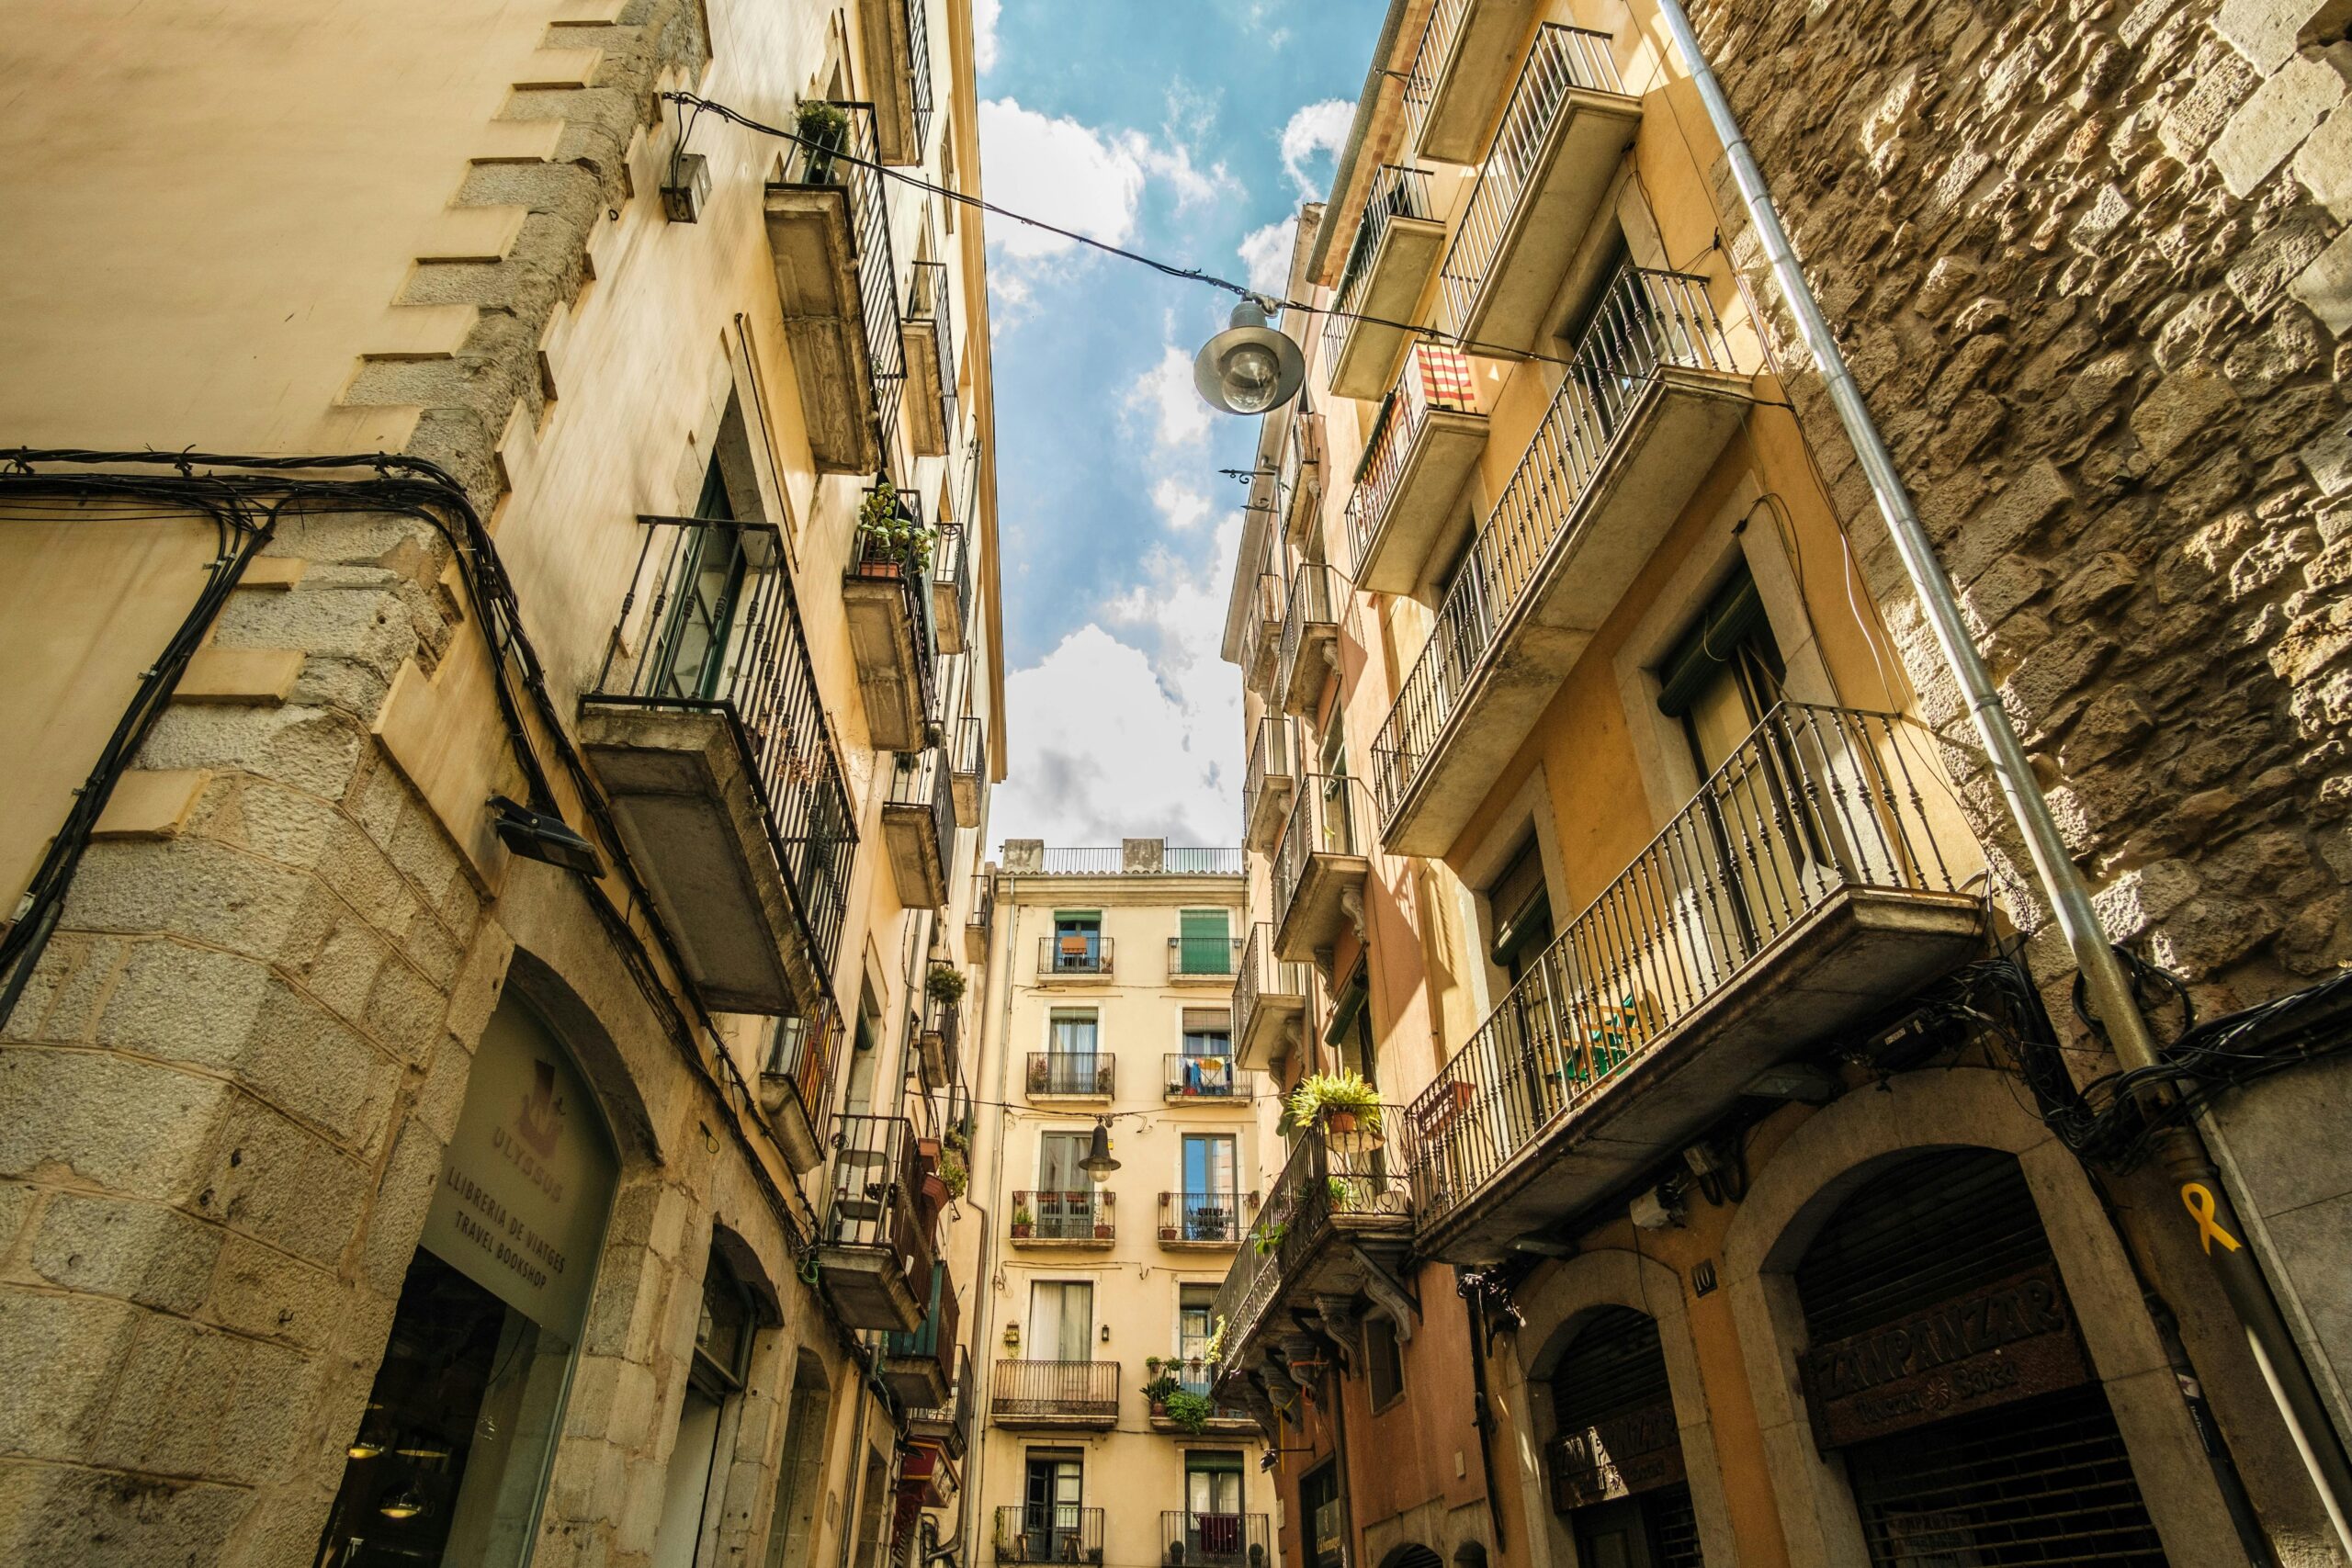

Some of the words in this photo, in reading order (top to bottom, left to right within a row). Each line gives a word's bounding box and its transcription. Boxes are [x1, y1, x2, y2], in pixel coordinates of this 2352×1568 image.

[492, 1126, 563, 1202] ULYSSUS
[447, 1166, 506, 1228] LLIBRERIA
[510, 1217, 525, 1241] DE
[526, 1230, 566, 1274] VIATGES
[456, 1210, 493, 1253] TRAVEL
[497, 1242, 547, 1291] BOOKSHOP
[1694, 1268, 1710, 1292] 10
